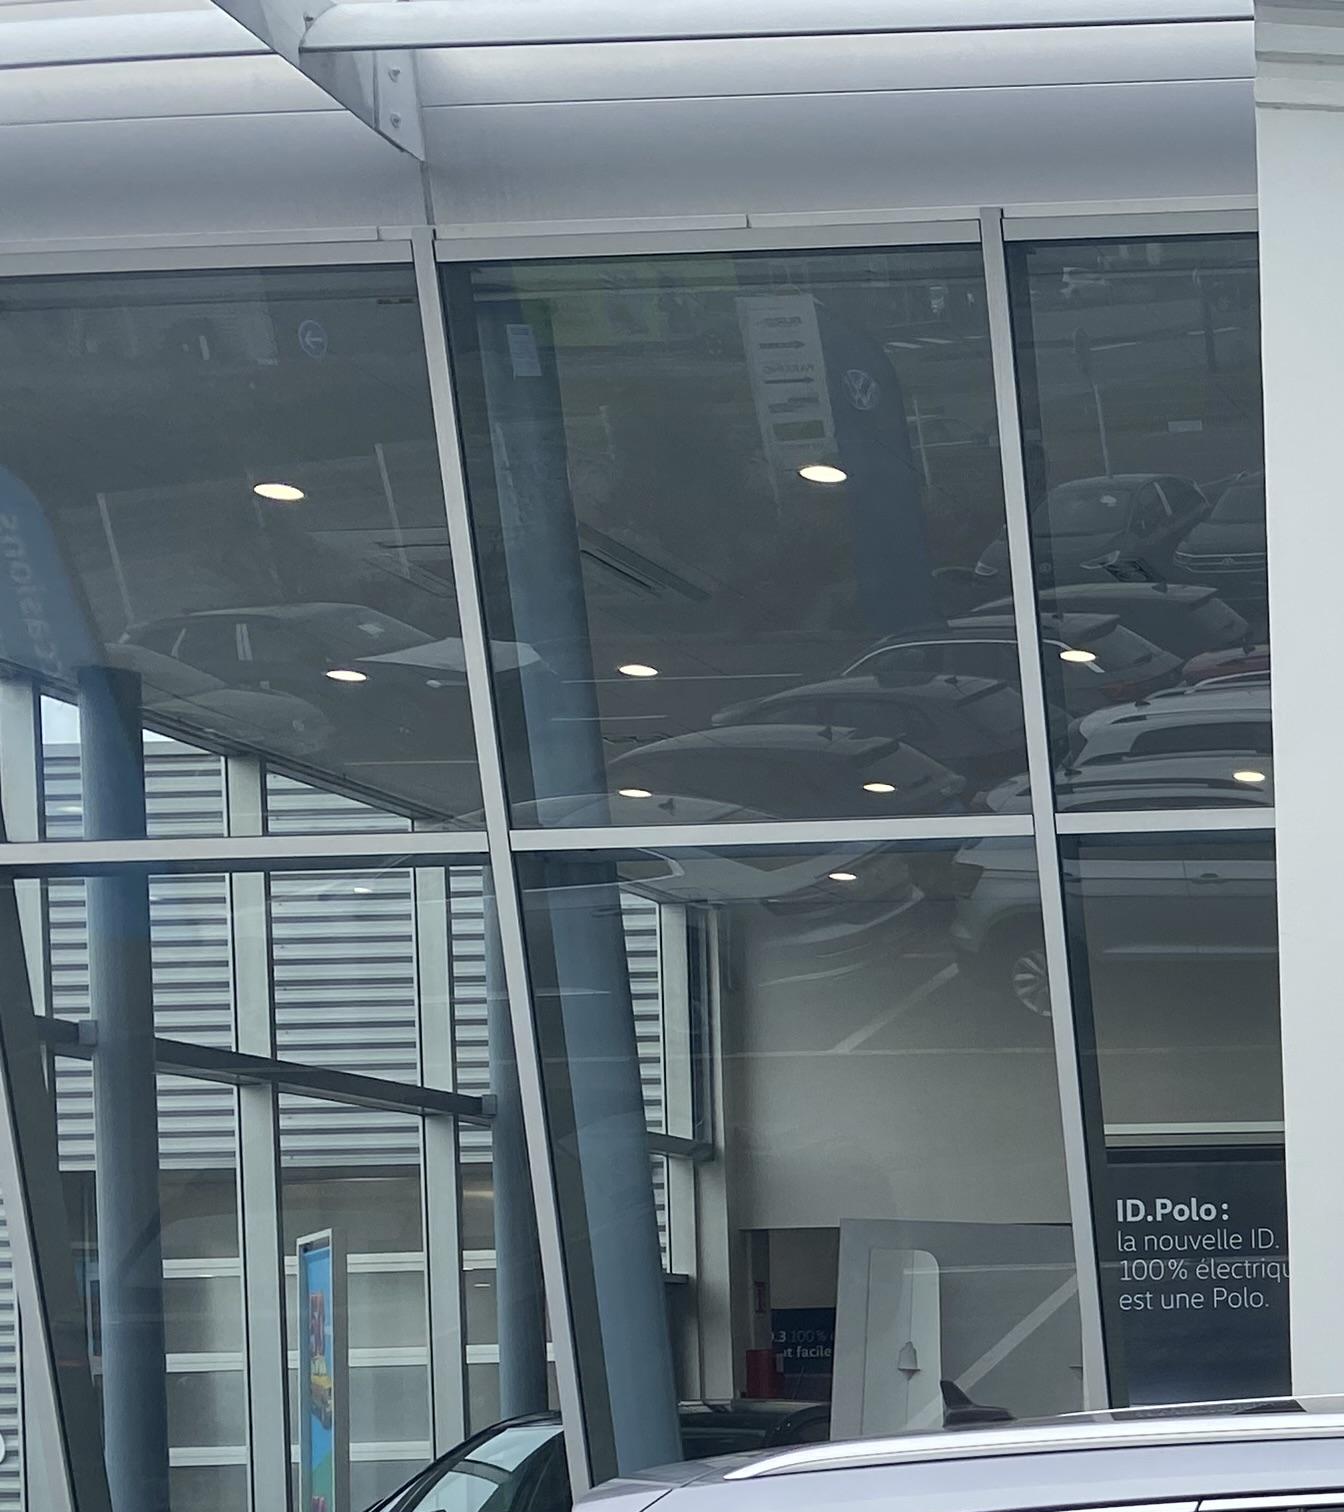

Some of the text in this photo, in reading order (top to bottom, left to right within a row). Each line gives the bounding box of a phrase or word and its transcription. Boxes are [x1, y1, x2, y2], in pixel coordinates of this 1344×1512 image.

[1118, 1228, 1280, 1251] la nouvelle ID.
[1120, 1259, 1188, 1281] 100%
[1119, 1287, 1269, 1310] est une Polo.
[797, 1345, 832, 1358] facile
